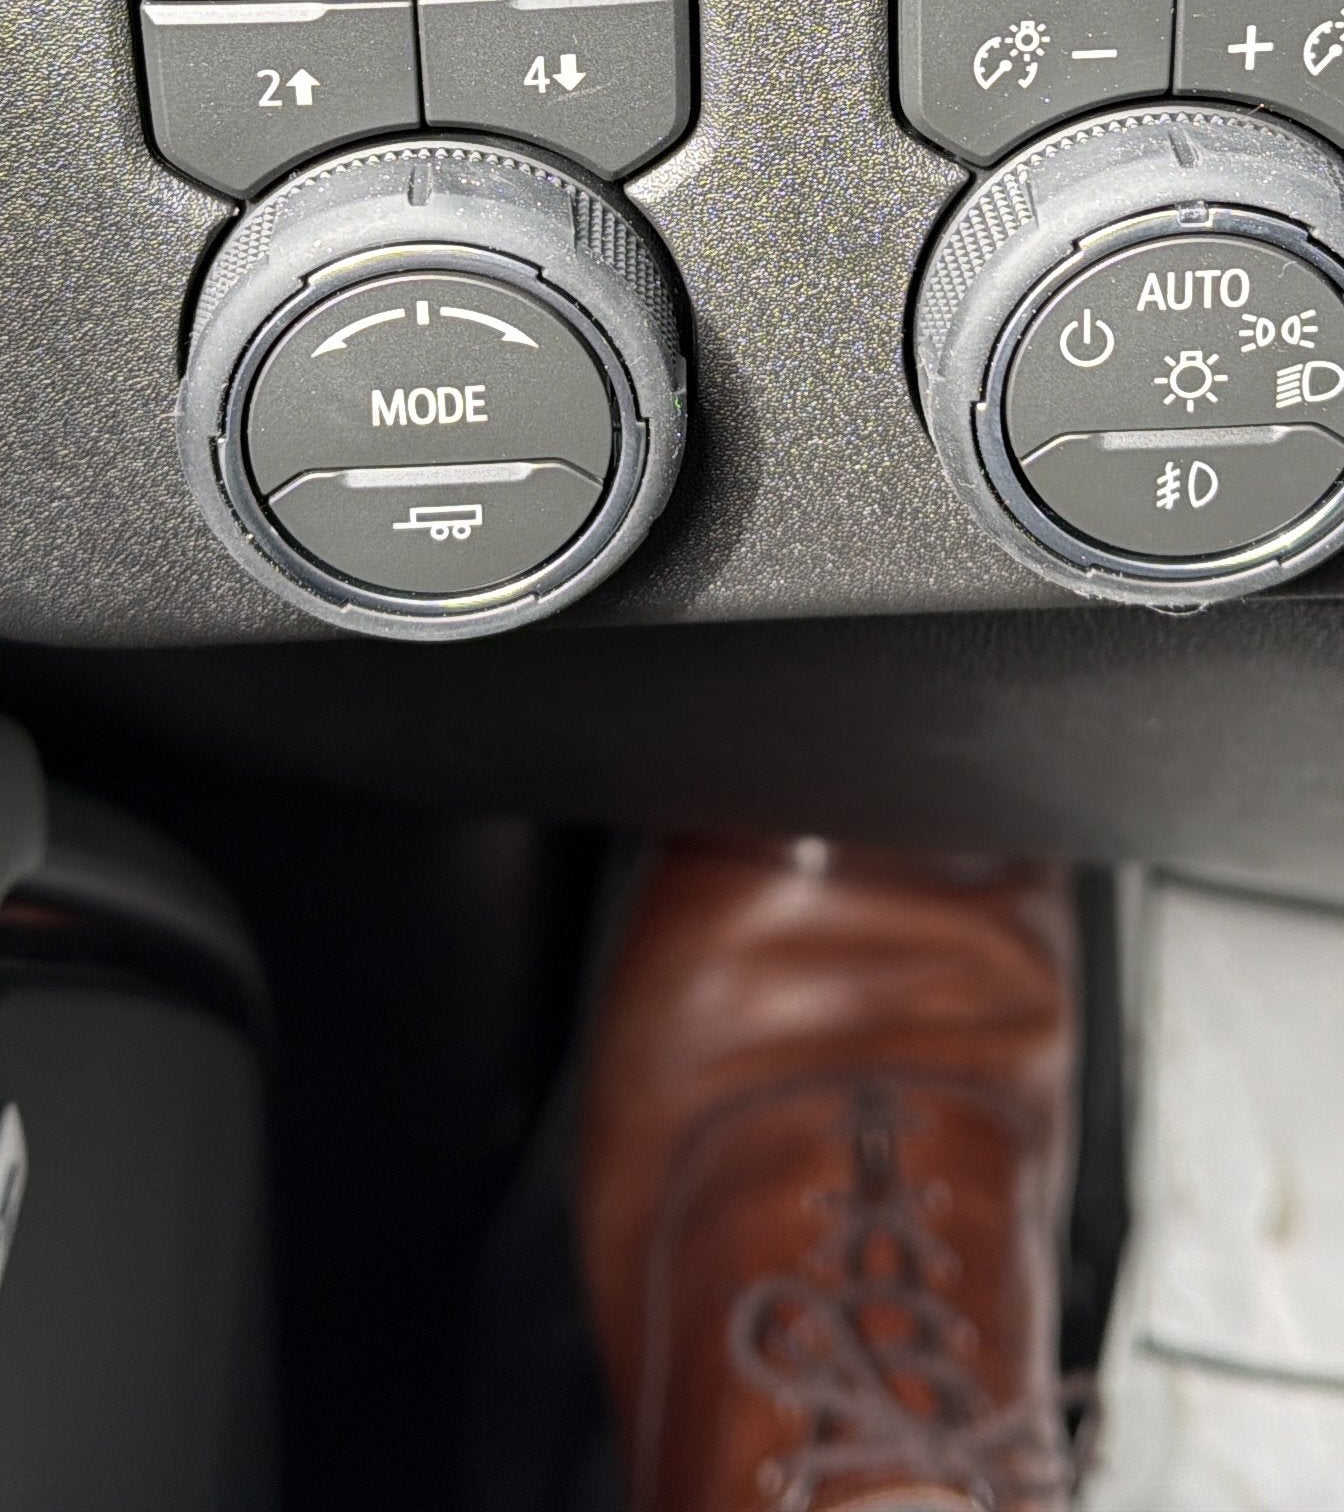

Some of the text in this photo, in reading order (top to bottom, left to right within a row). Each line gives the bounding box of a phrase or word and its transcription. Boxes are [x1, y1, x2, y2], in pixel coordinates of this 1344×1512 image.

[255, 68, 285, 108] 2
[522, 54, 552, 95] 4
[1135, 267, 1251, 313] AUTO
[370, 383, 490, 428] MODE
